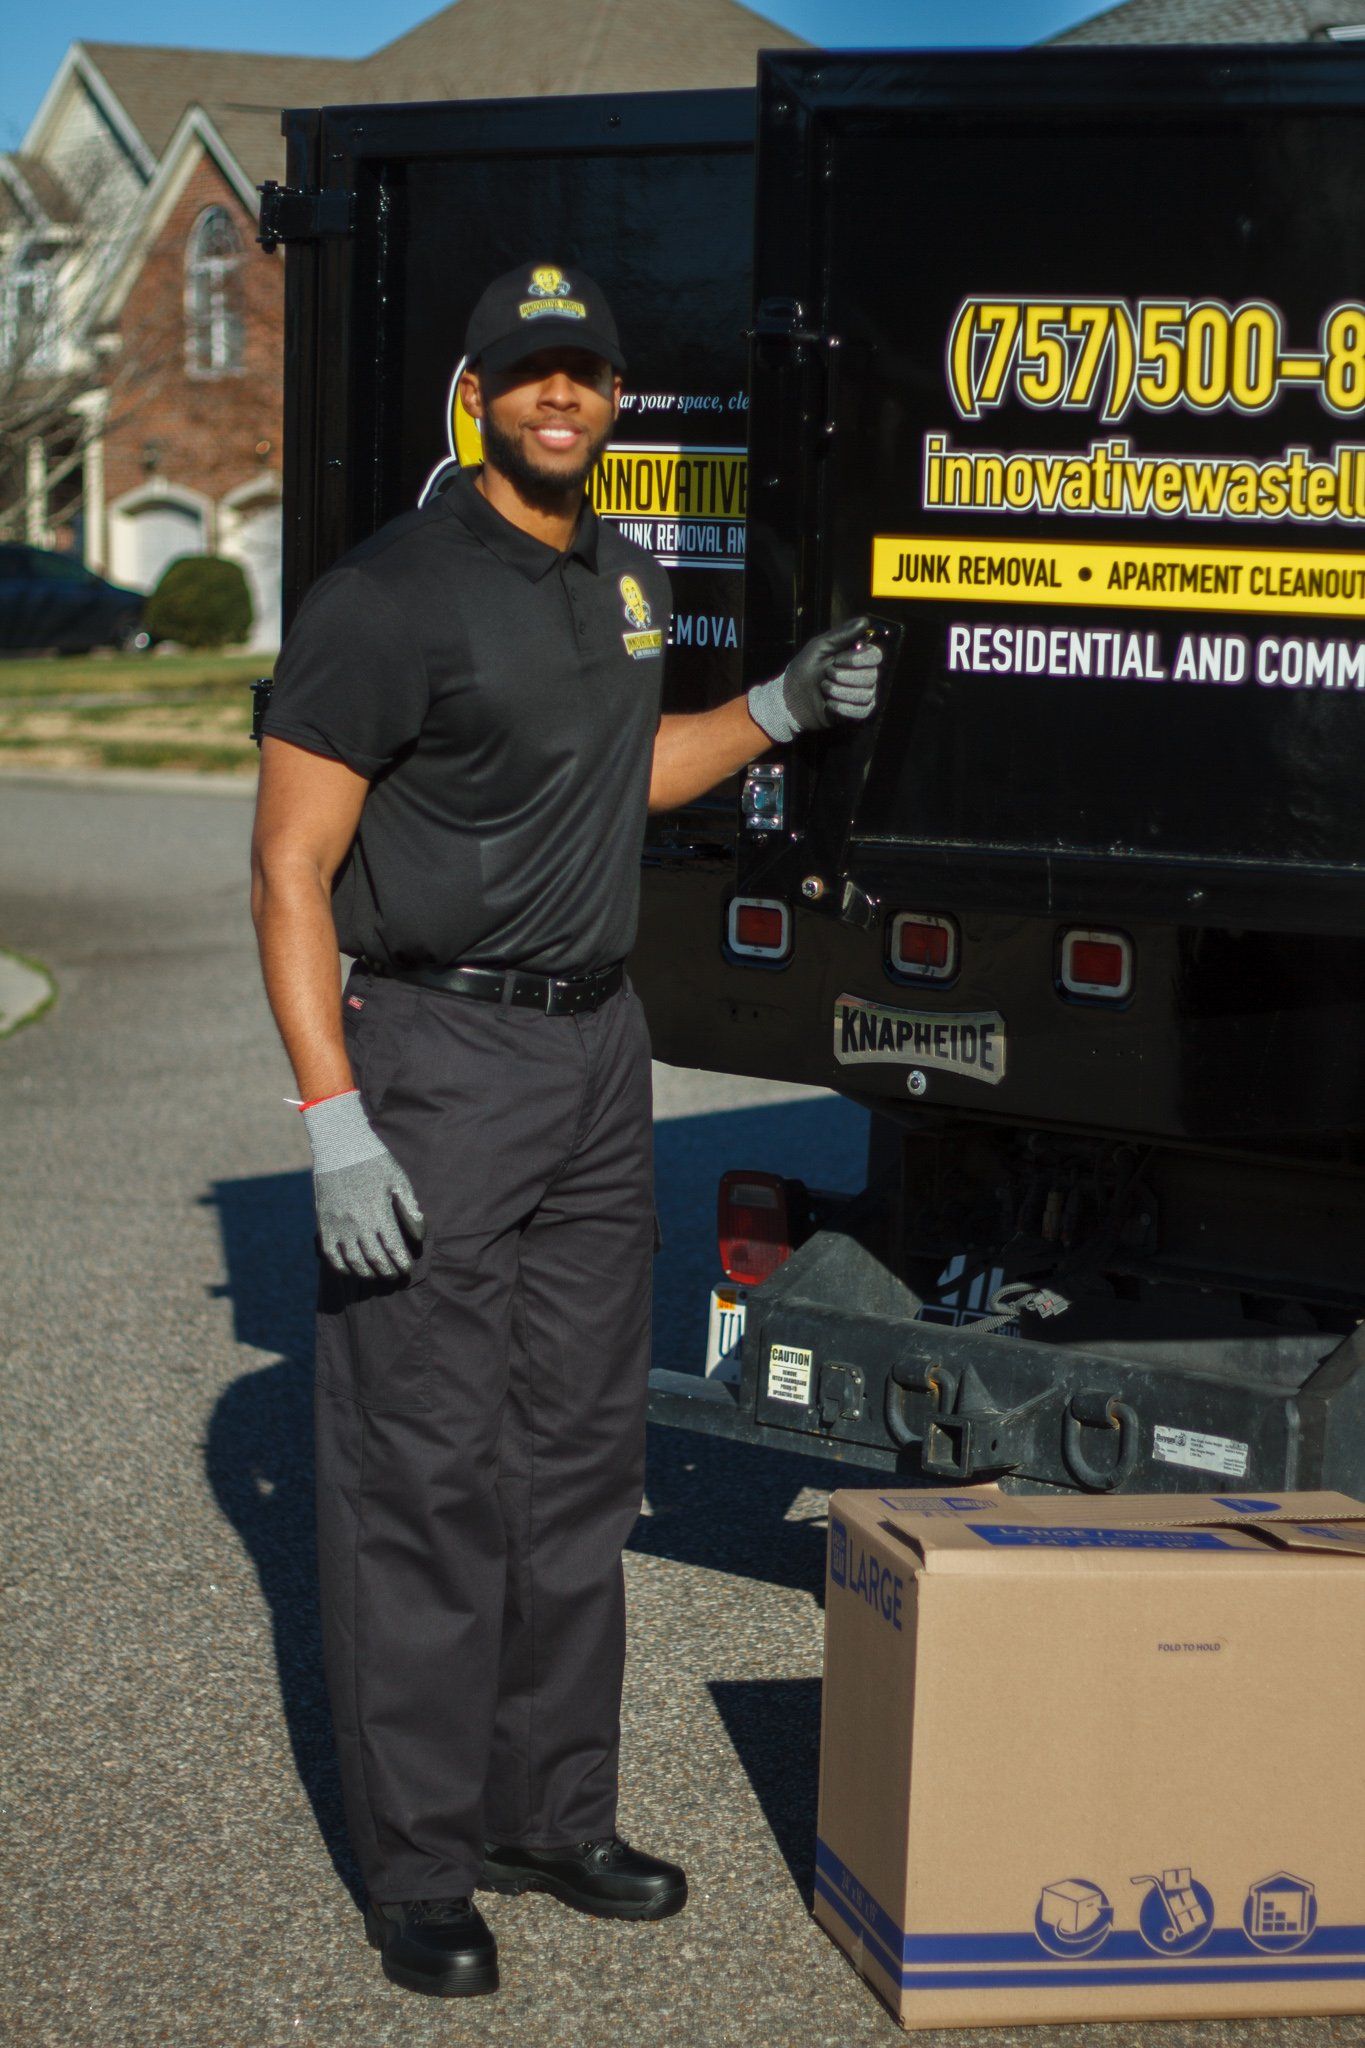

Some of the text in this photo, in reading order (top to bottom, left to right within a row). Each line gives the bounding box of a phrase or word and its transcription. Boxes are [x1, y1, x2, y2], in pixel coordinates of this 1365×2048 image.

[638, 394, 676, 413] your
[677, 395, 724, 414] space,
[657, 524, 723, 553] REMOVAL
[892, 553, 1365, 599] JUNK REMOVAL APARTMENT CLEANOUT
[949, 626, 1365, 688] RESIDENTIAL AND COMM
[841, 1006, 995, 1072] KNAPHEIDE
[772, 1348, 810, 1366] CAUTION
[849, 1539, 903, 1632] LARGE
[1158, 1643, 1221, 1652] FOLD TO HOLD
